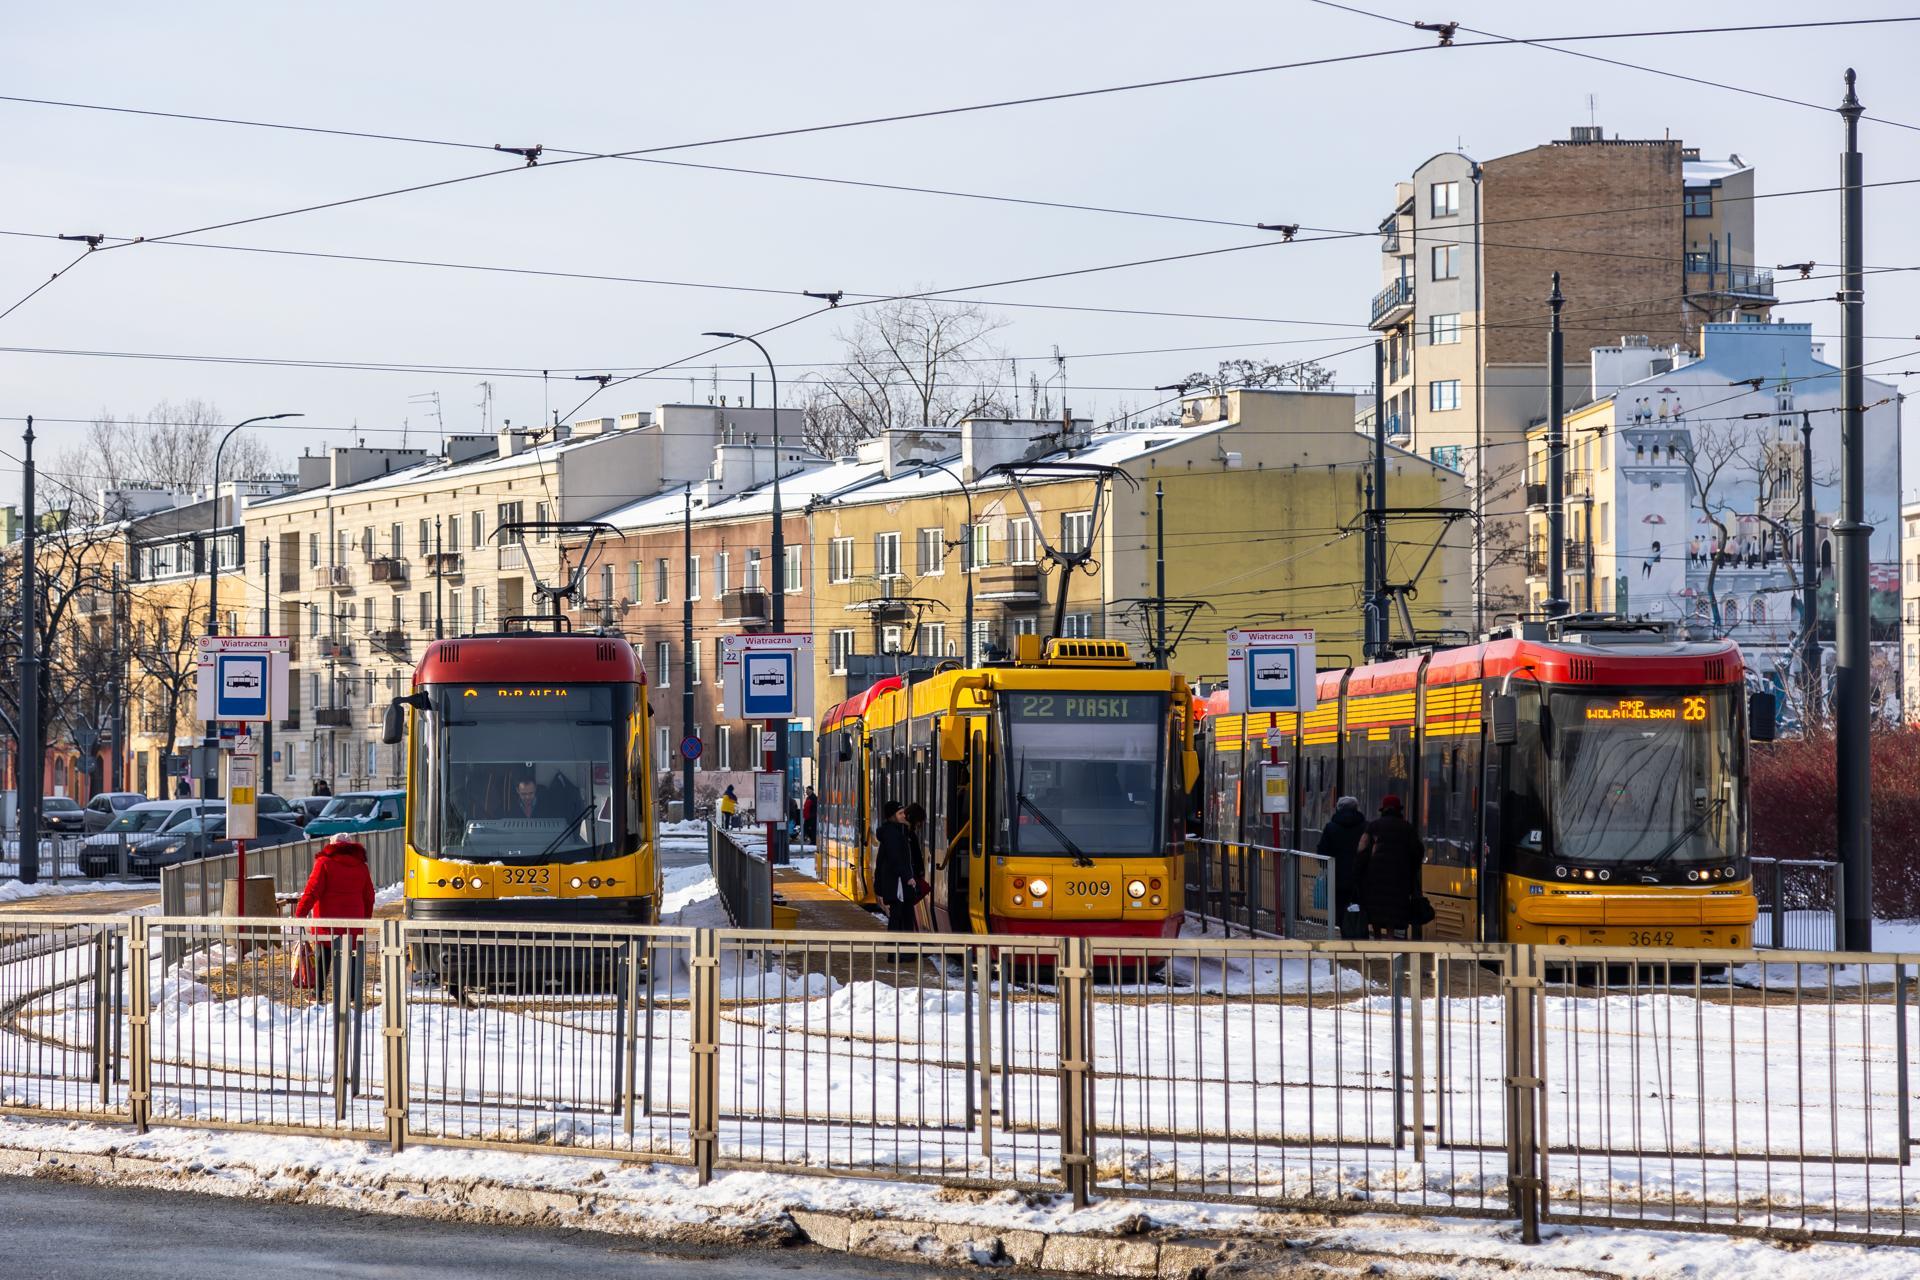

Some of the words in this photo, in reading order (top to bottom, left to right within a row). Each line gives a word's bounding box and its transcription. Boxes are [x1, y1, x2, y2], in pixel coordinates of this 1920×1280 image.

[745, 637, 792, 645] Wiatraczna
[802, 636, 812, 644] 12
[1248, 632, 1294, 640] Wiatraczna
[1303, 632, 1313, 640] 13
[221, 639, 268, 647] Wiatraczna
[203, 654, 209, 662] 9
[1023, 696, 1054, 717] 22
[1066, 698, 1128, 718] PIASKI
[1619, 700, 1645, 710] PKP
[1683, 697, 1706, 720] 26
[502, 868, 550, 884] 3223
[1064, 880, 1111, 896] 3009
[1628, 931, 1675, 946] 3642
